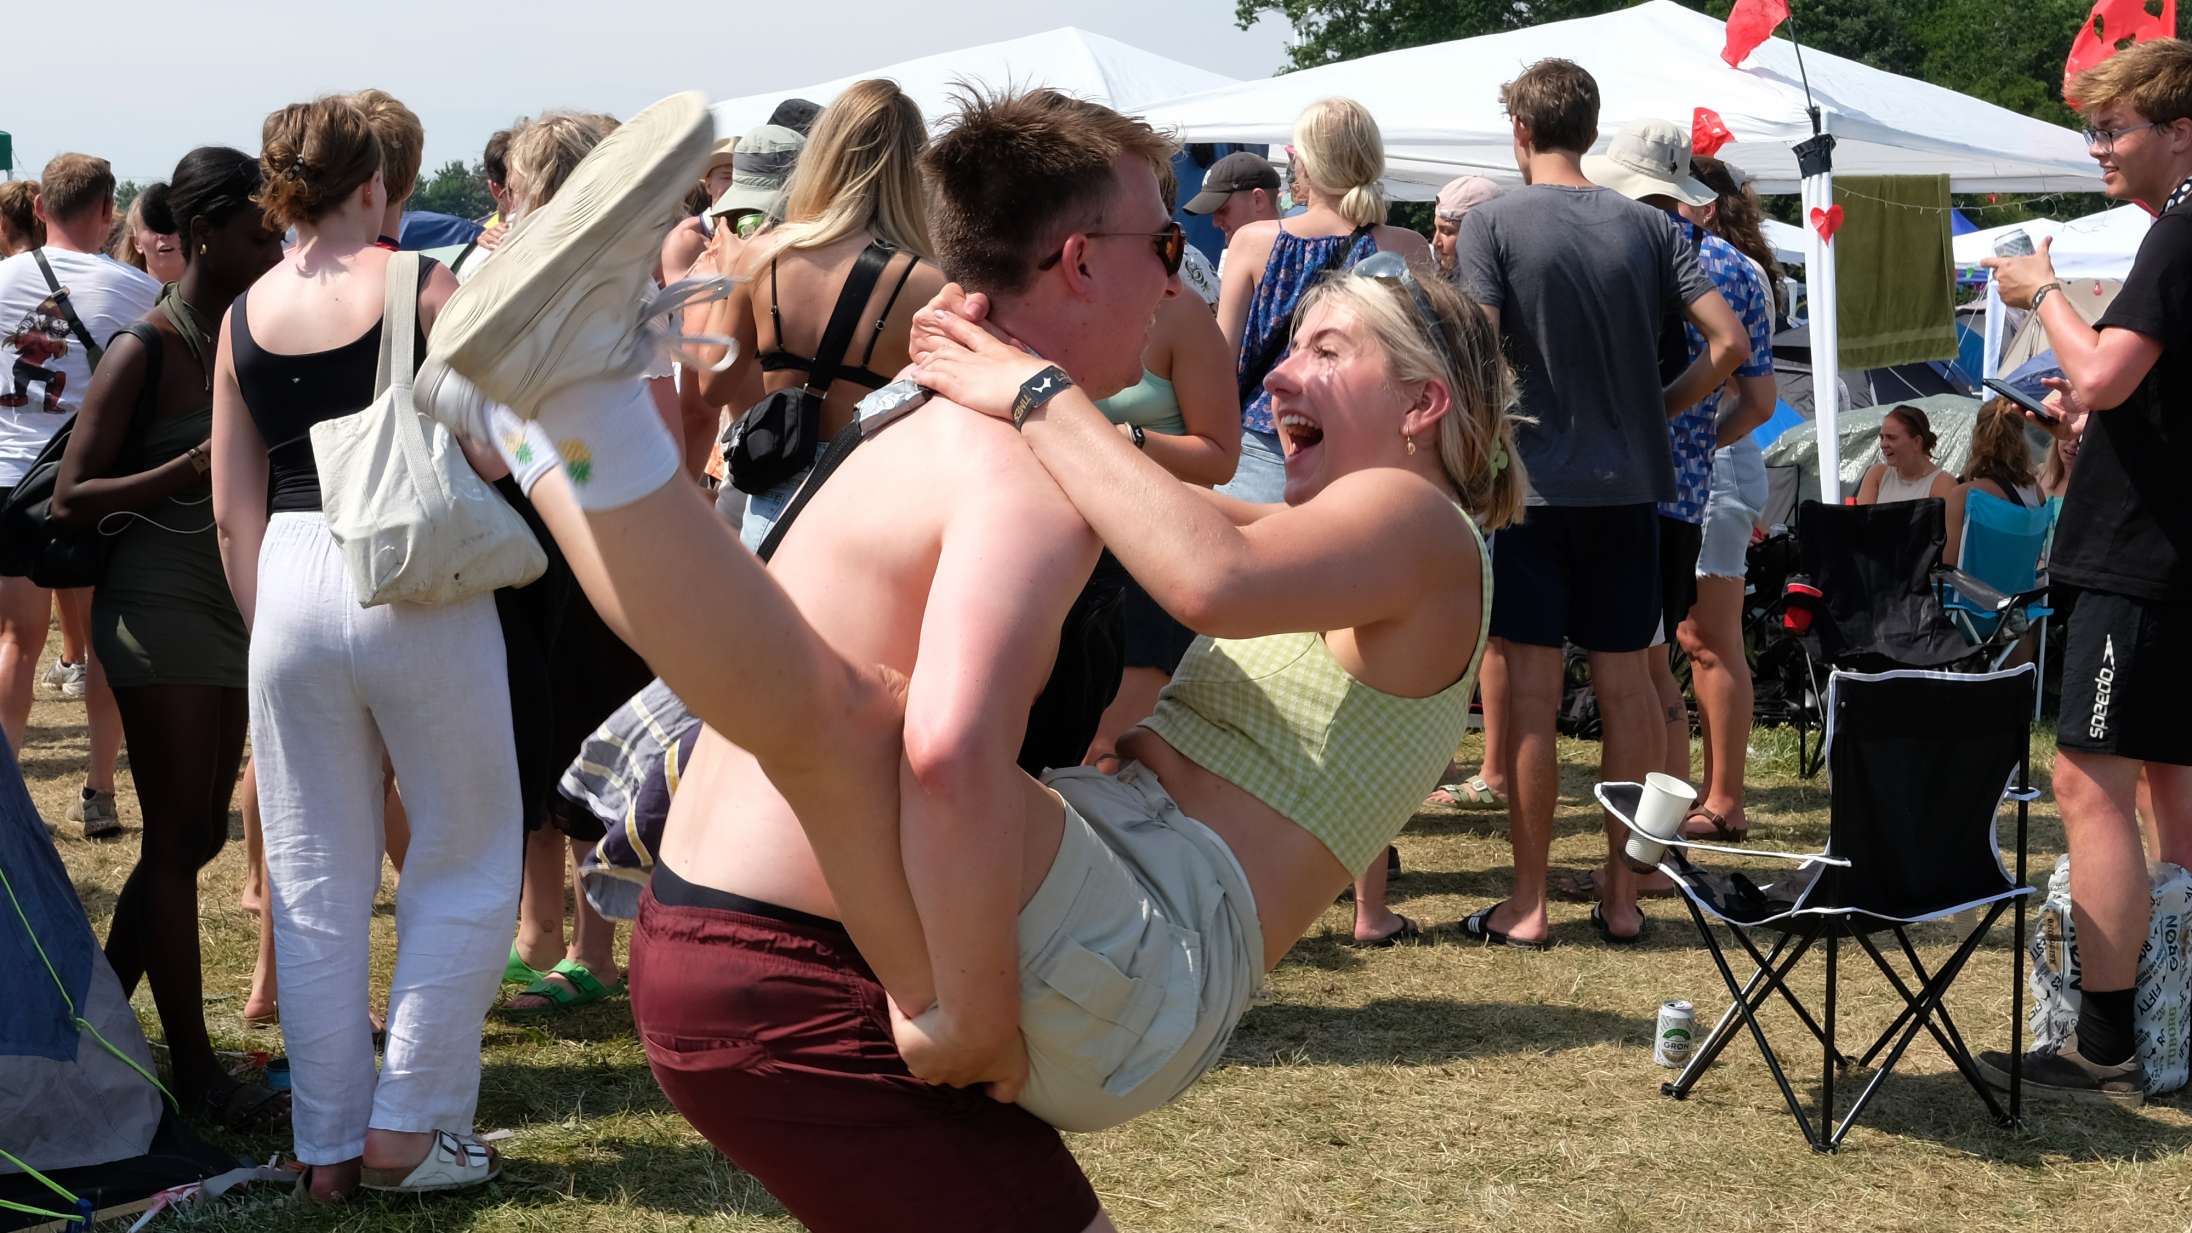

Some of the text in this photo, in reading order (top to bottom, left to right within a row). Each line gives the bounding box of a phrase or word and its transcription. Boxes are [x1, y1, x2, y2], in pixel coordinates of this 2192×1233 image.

[2089, 667, 2114, 740] speedo
[2165, 915, 2179, 972] GRØN
[2137, 983, 2162, 1016] FIFTY
